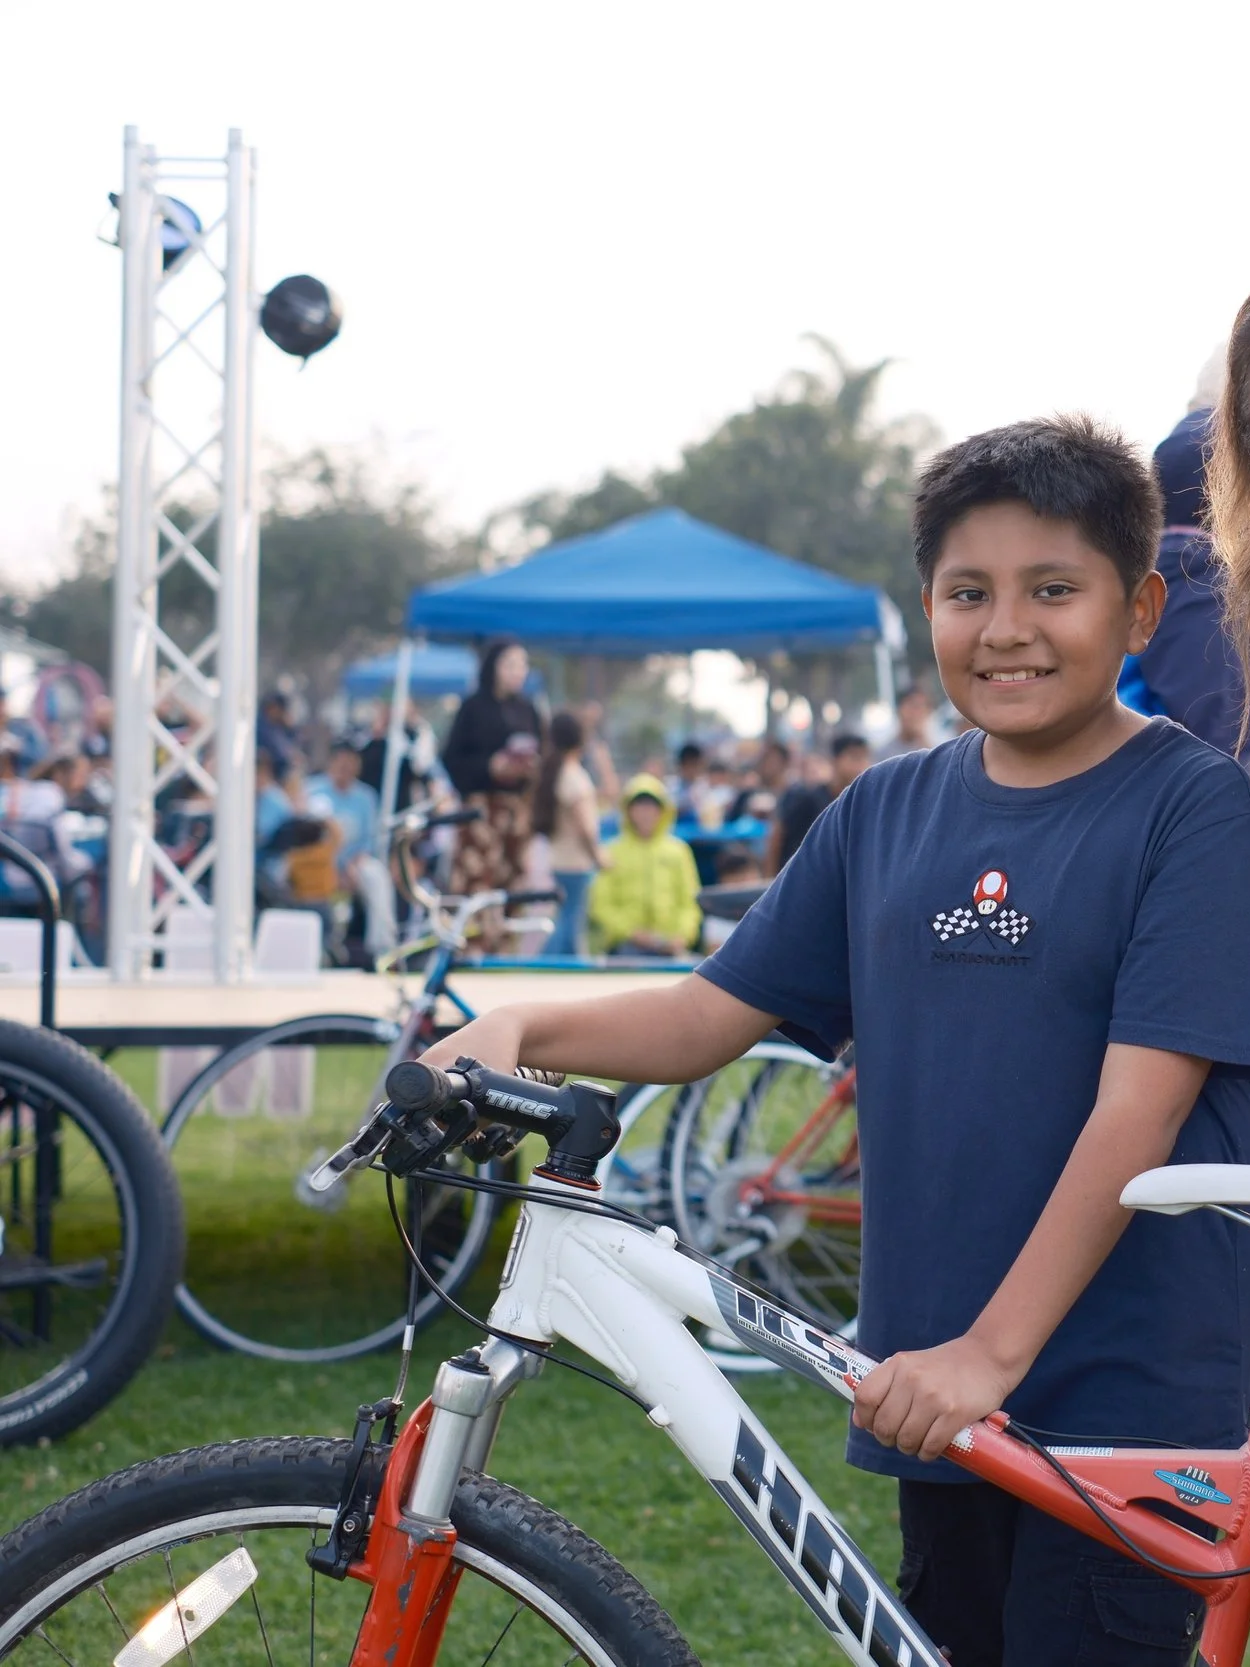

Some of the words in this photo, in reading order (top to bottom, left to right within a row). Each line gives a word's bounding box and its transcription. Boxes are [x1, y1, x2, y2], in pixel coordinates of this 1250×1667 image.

[737, 1317, 777, 1345] INTEGRATED
[777, 1340, 817, 1367] COMPONENT
[817, 1362, 843, 1381] SYSTEM
[1186, 1465, 1210, 1483] PURE
[1171, 1475, 1216, 1498] SHIMANO
[1179, 1493, 1199, 1504] guts
